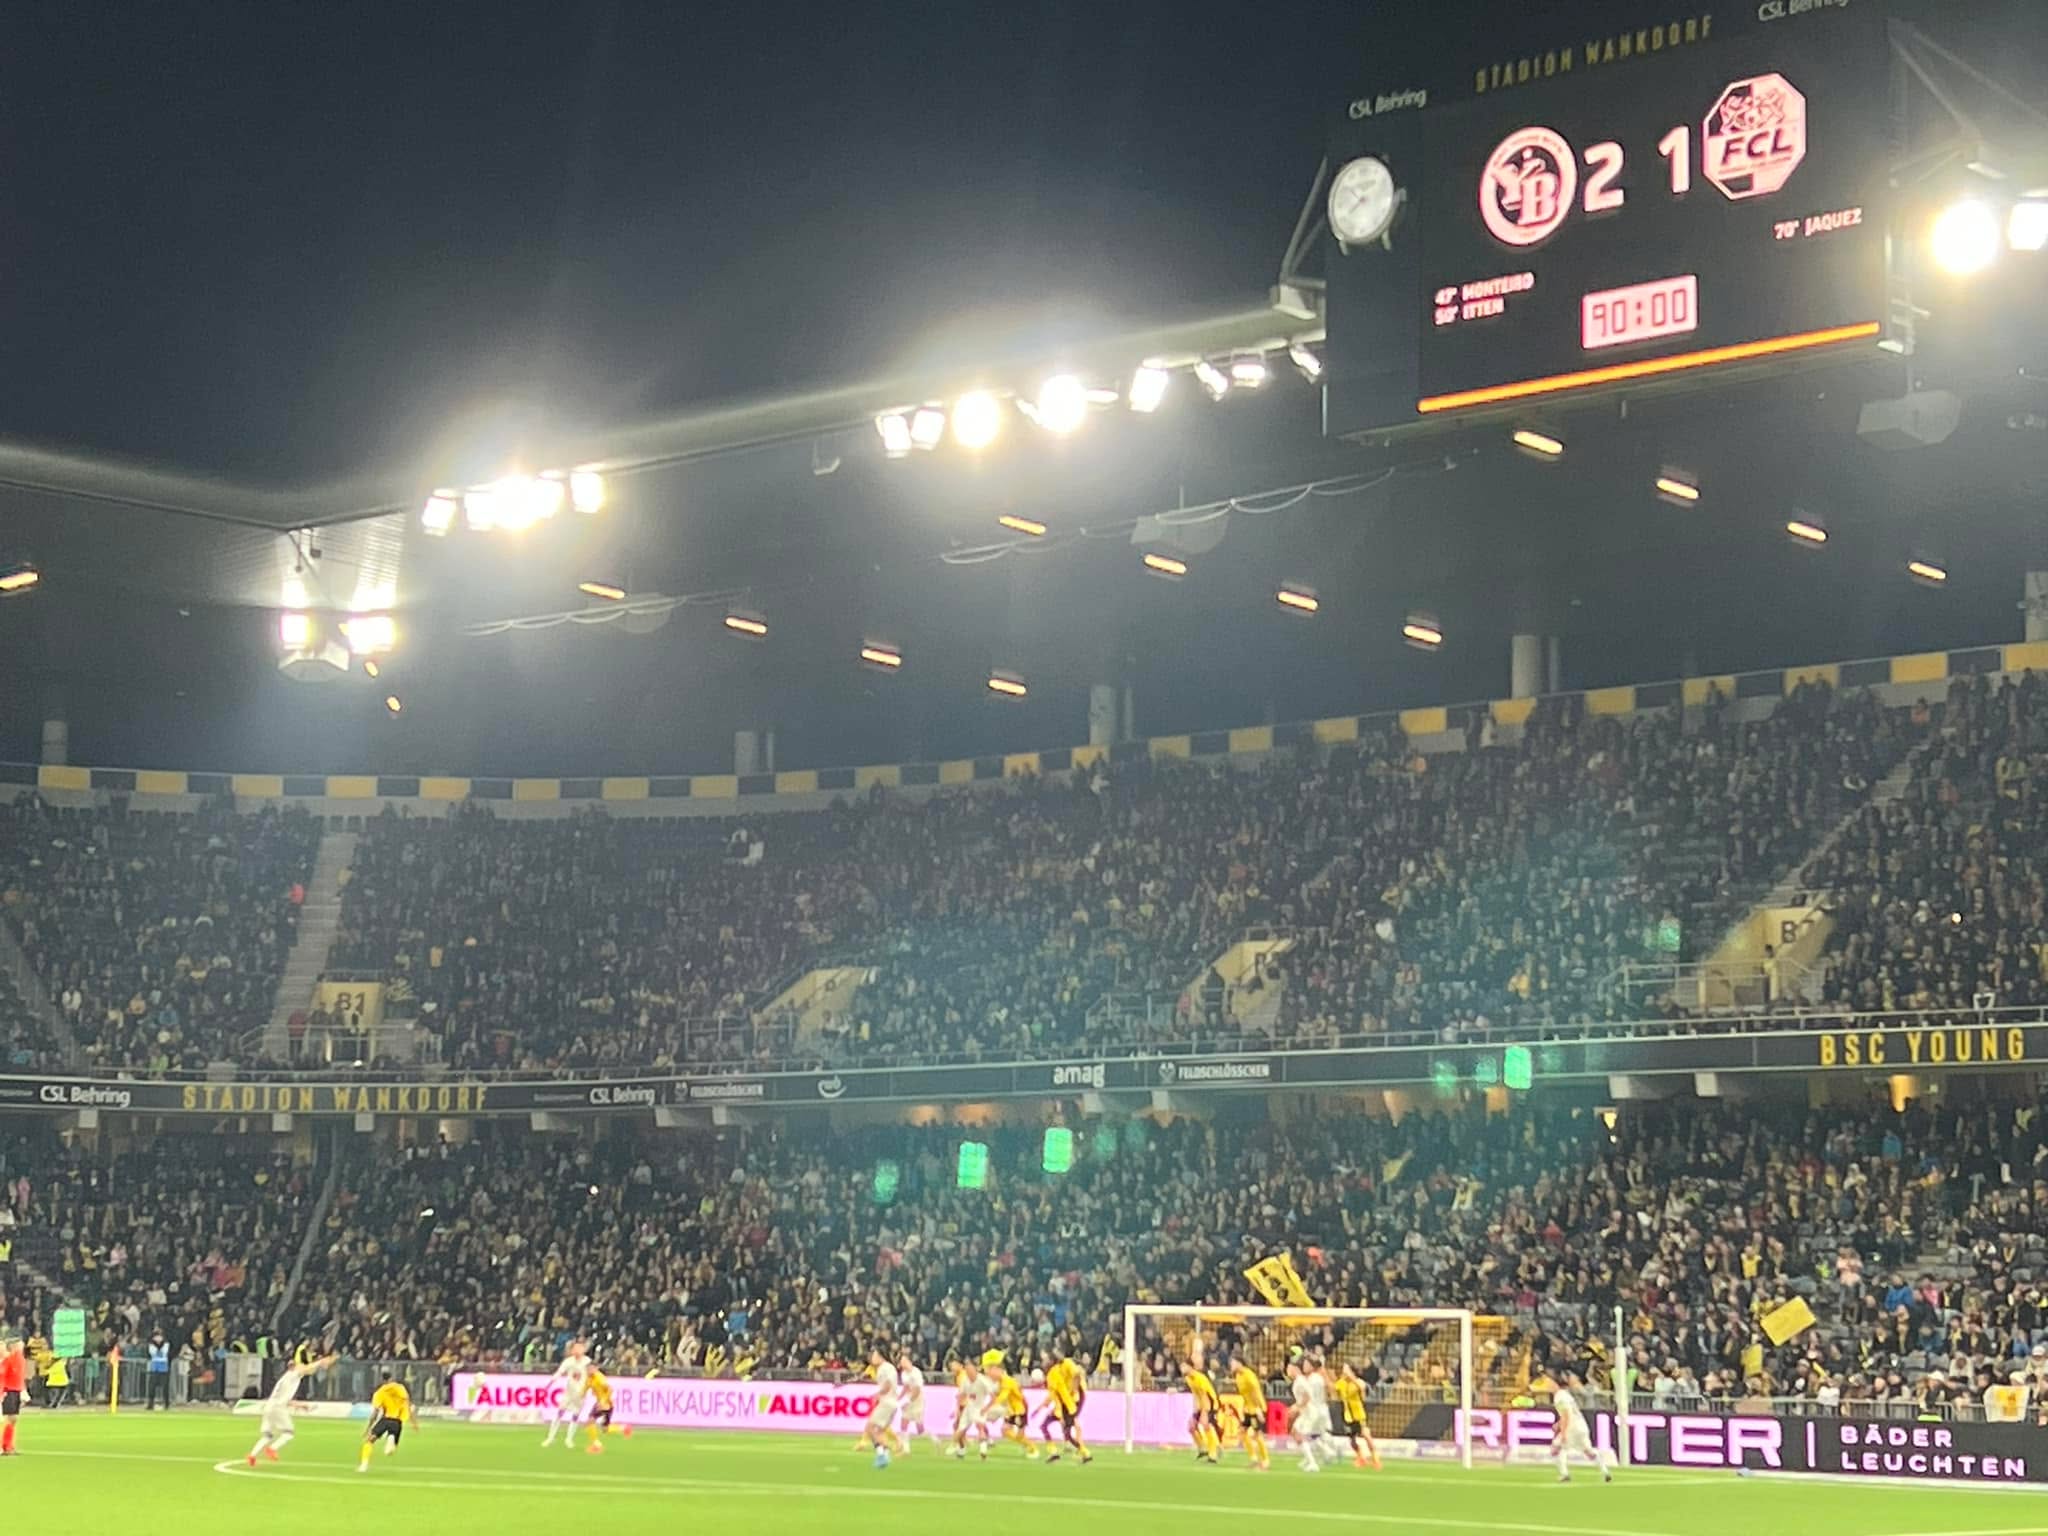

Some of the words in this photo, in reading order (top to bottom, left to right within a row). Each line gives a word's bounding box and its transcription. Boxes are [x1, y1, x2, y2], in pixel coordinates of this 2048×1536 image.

[1348, 99, 1373, 119] CSL
[1657, 125, 1691, 193] 1
[1720, 127, 1793, 167] FCL
[1584, 141, 1625, 212] 2
[1592, 288, 1688, 338] 90:00
[1820, 1031, 1885, 1066] BSC
[1906, 1027, 2025, 1064] YOUNG
[1053, 1063, 1105, 1088] amag
[40, 1085, 68, 1102] CSL
[71, 1085, 131, 1108] Behring
[183, 1085, 314, 1112] STADION
[333, 1086, 488, 1113] WANKDORF
[589, 1087, 611, 1104] CSL
[613, 1085, 656, 1106] Behring
[768, 1394, 875, 1418] ALIGRO
[1840, 1423, 1953, 1448] BÄDER
[1841, 1451, 2026, 1477] LEUCHTEN
